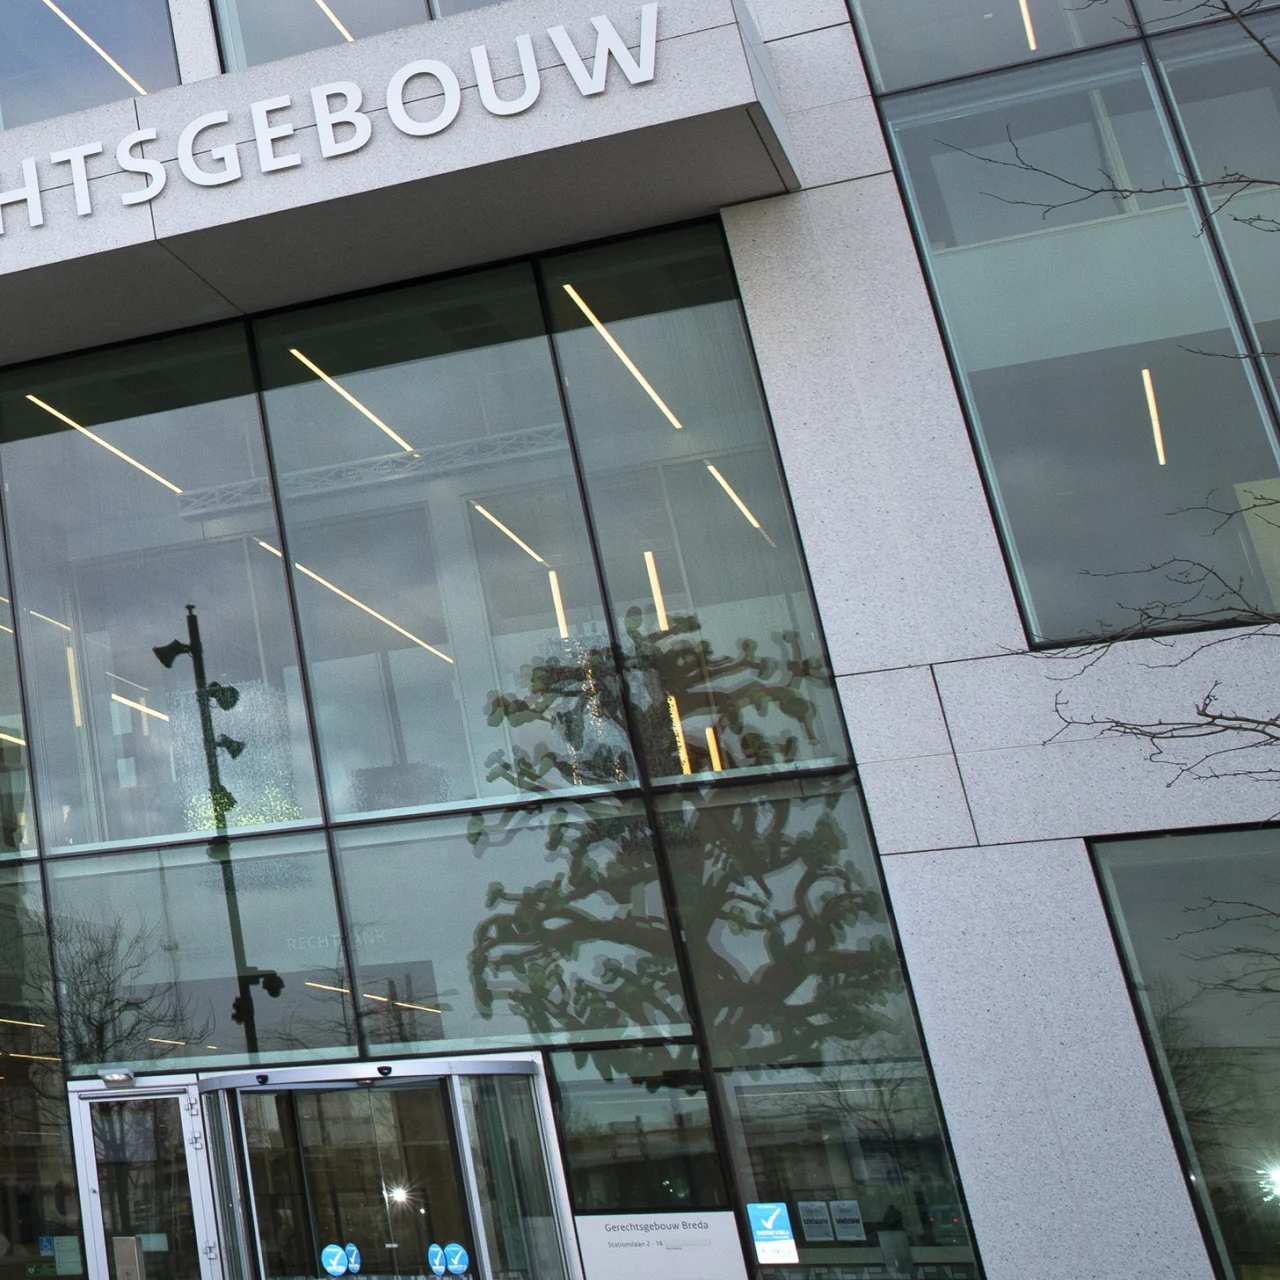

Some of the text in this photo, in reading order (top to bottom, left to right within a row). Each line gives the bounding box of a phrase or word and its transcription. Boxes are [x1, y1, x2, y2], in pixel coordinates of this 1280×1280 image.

[288, 930, 387, 951] RECHTANK
[605, 1220, 709, 1233] Gerechtsgebouw Breda
